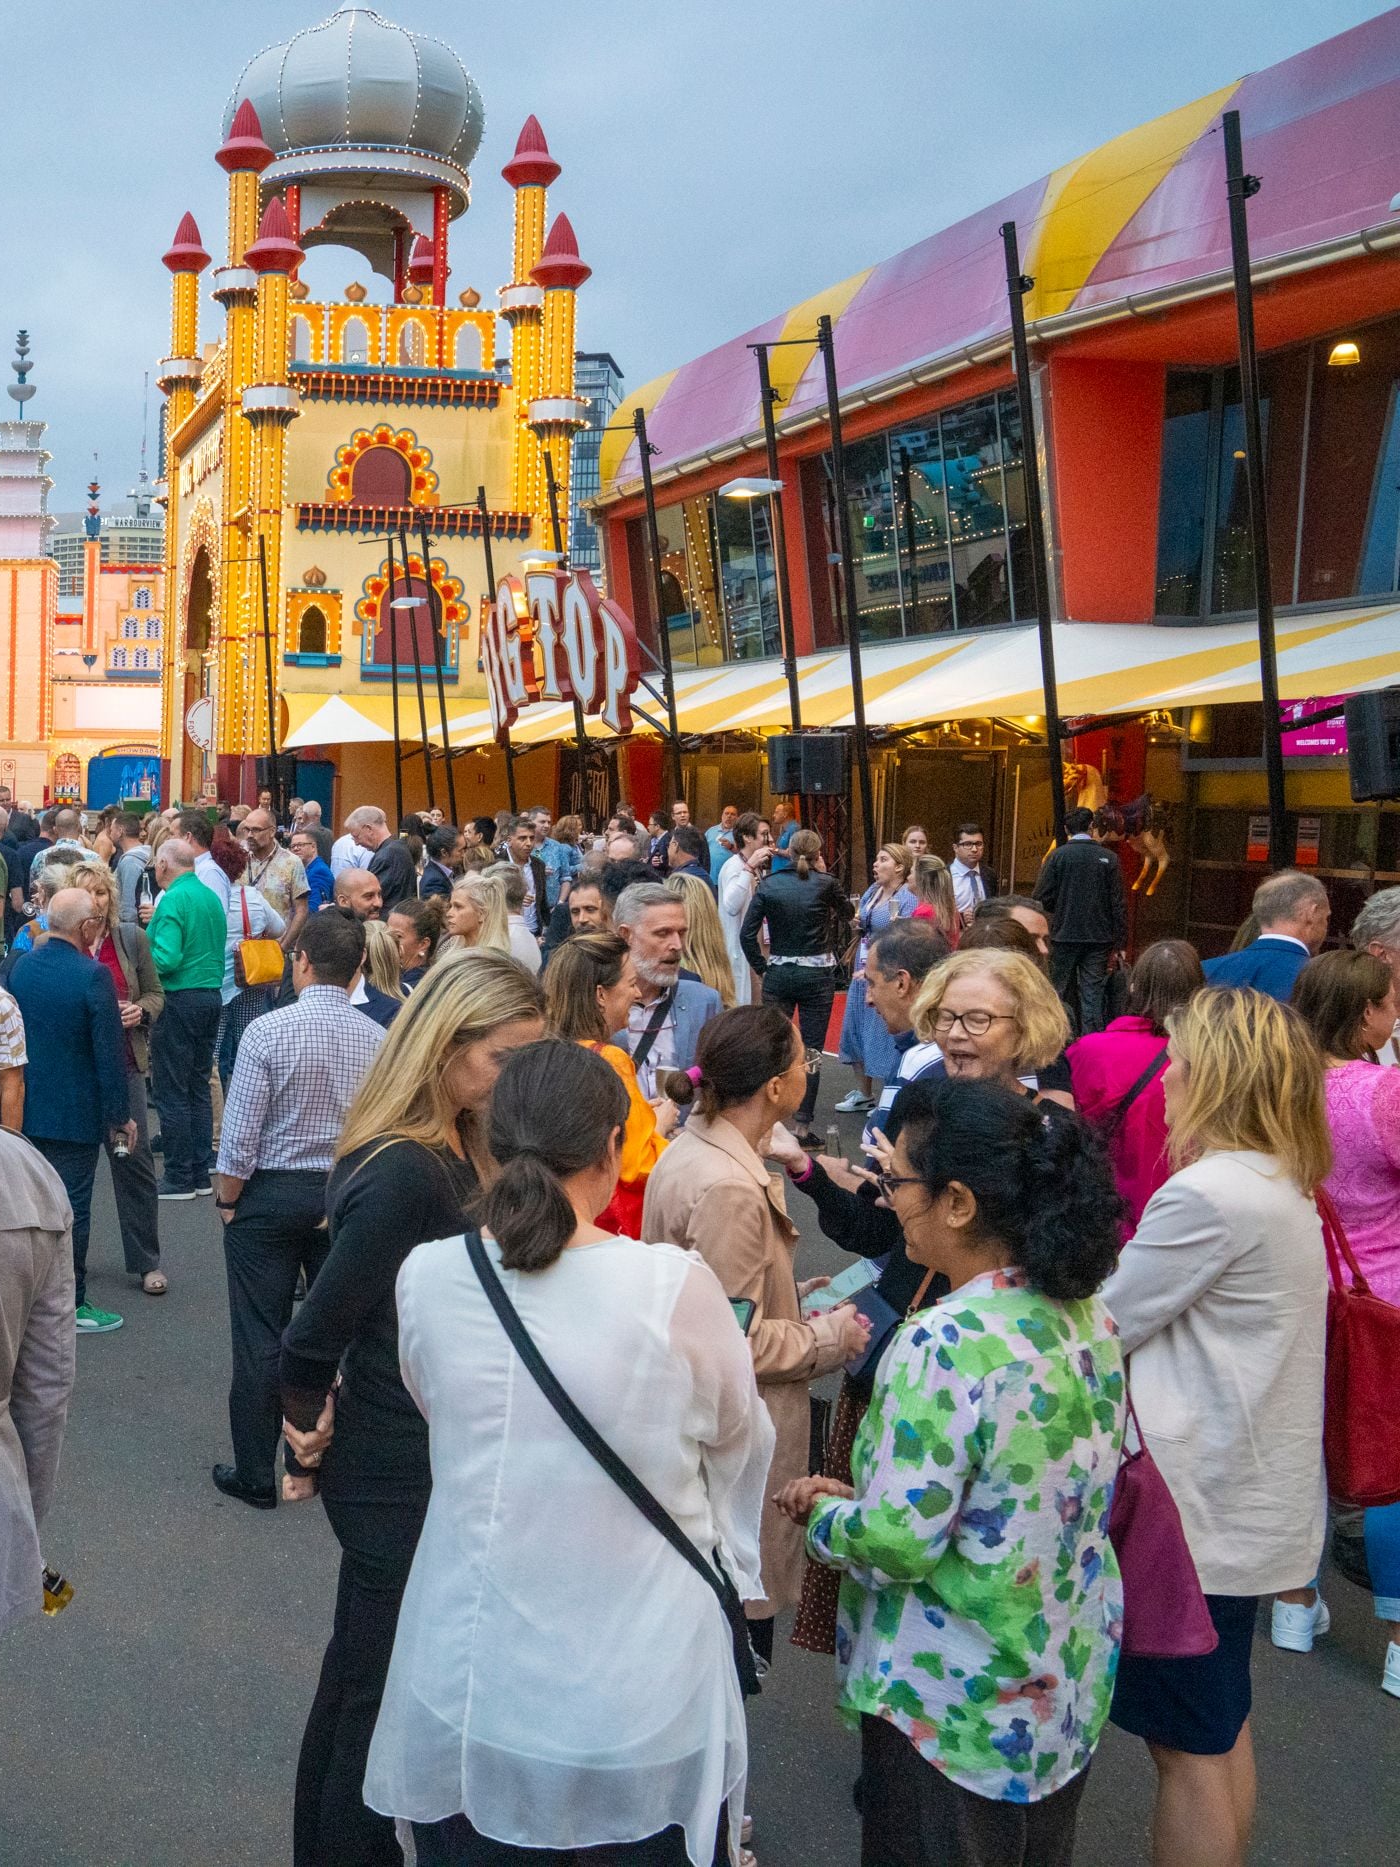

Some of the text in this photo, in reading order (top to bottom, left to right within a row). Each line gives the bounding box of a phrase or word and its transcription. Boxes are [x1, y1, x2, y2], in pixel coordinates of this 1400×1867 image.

[525, 570, 640, 735] TOP
[187, 720, 211, 750] FOYER 2
[1320, 738, 1329, 746] YOU
